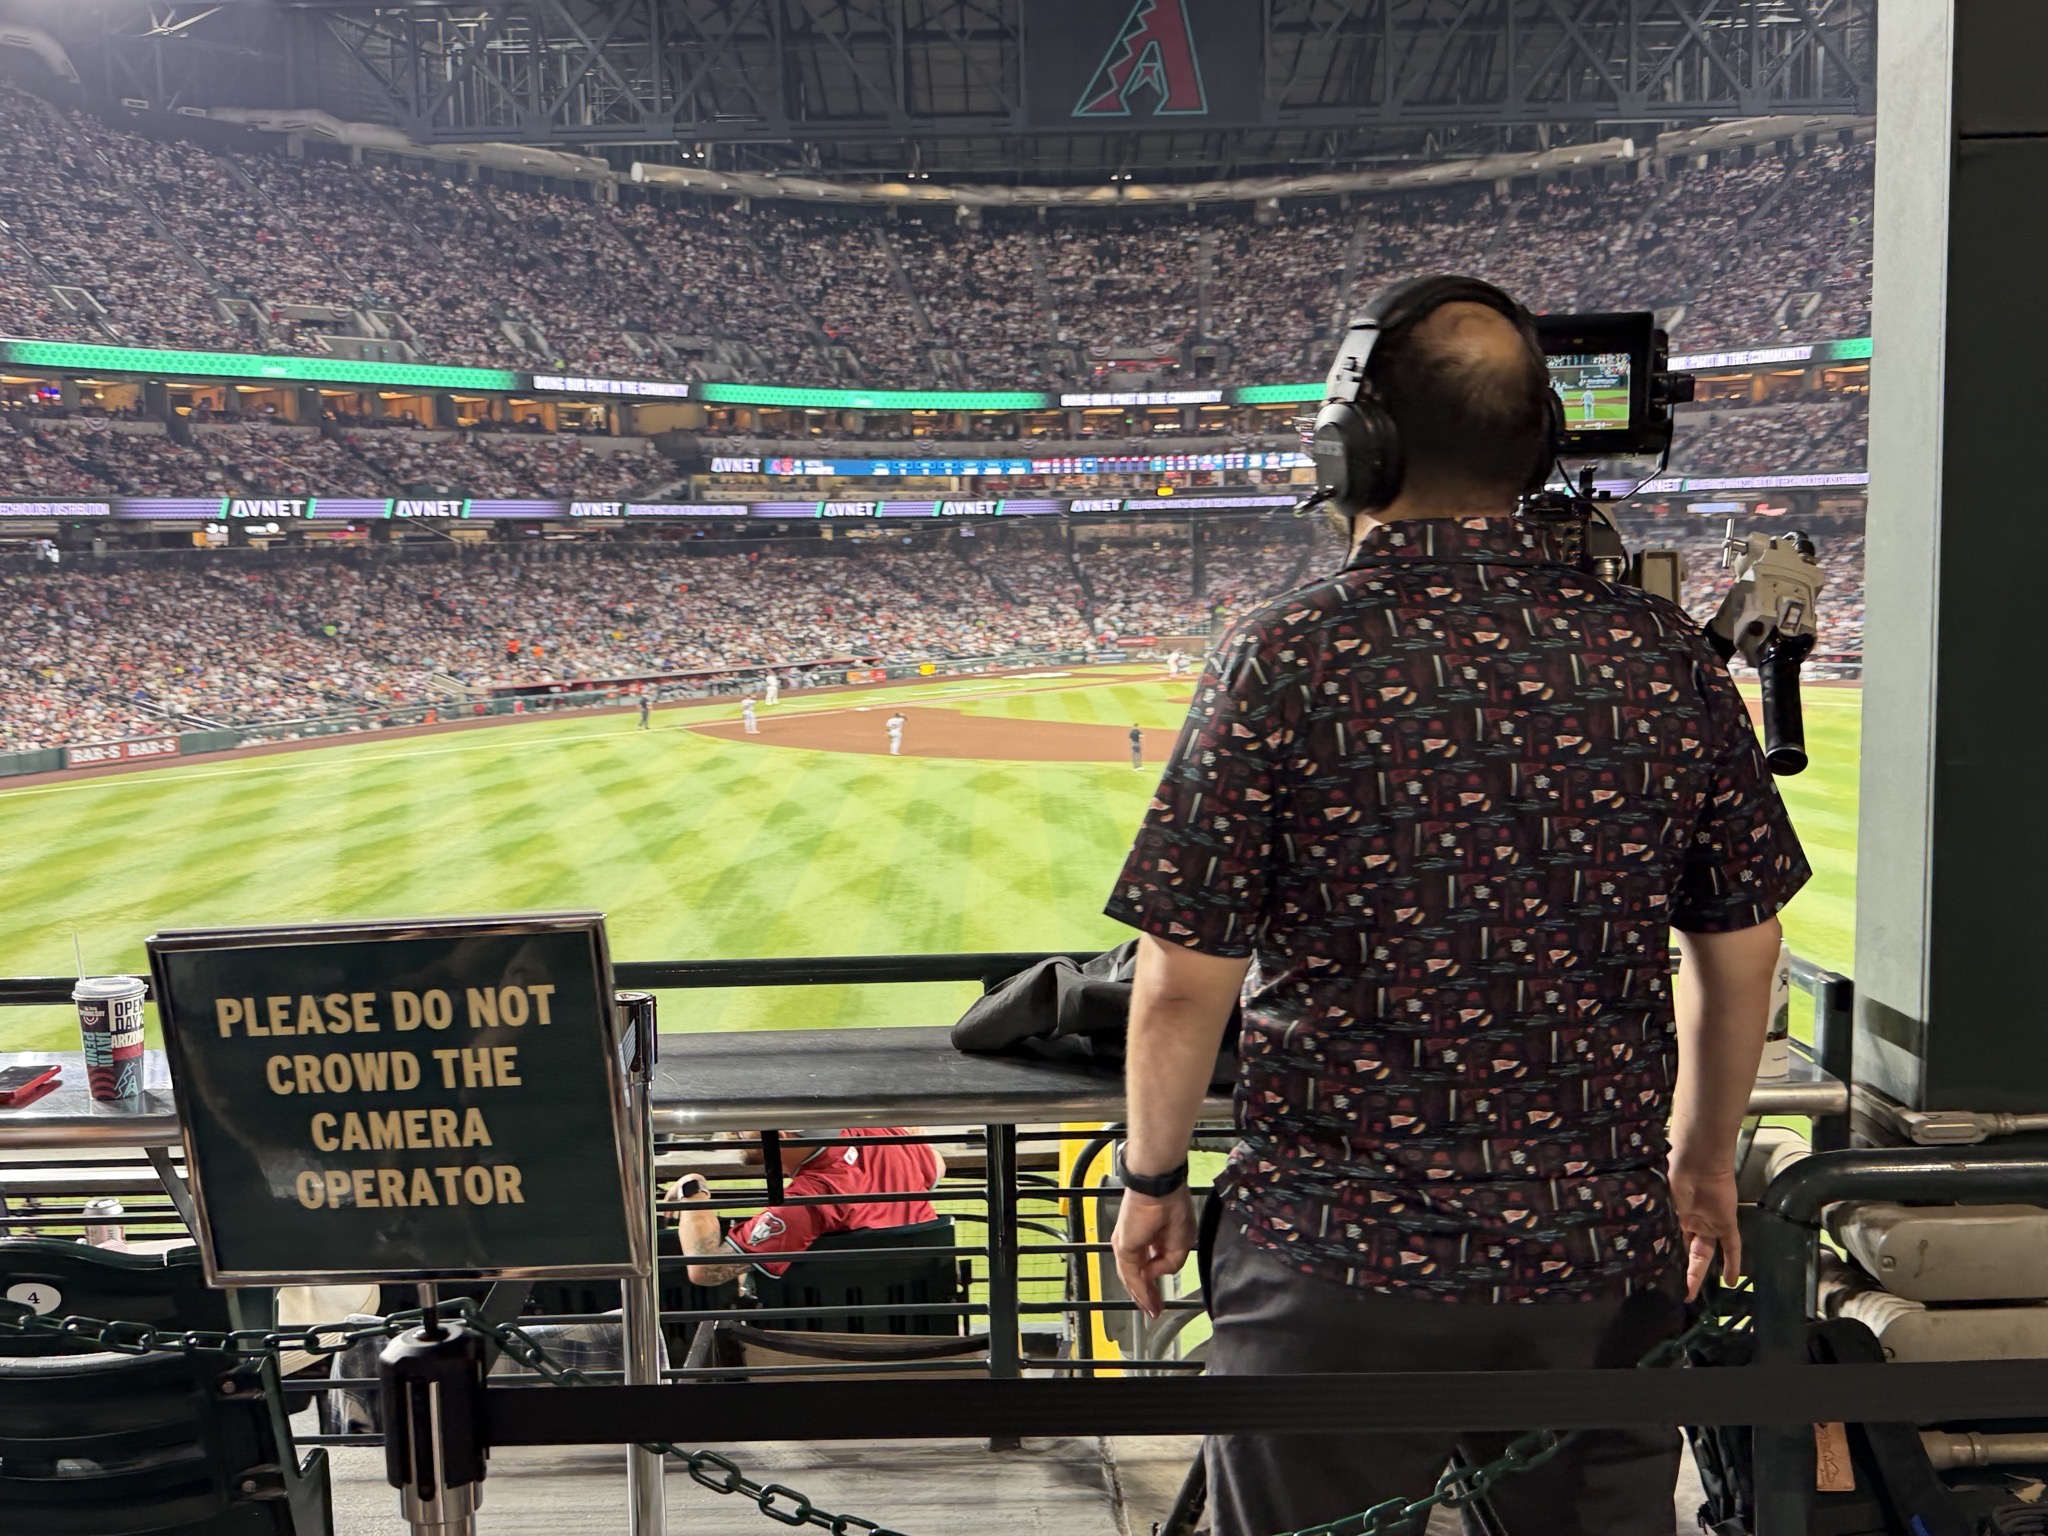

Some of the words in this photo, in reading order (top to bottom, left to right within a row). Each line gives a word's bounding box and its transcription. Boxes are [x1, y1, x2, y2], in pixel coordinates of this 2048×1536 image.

[711, 458, 760, 473] AVNET
[230, 500, 306, 517] AVNET
[395, 500, 463, 517] AVNET
[569, 502, 623, 516] AVNET
[823, 502, 876, 517] AVNET
[942, 501, 997, 516] AVNET
[70, 745, 121, 763] BAR-S
[127, 739, 176, 757] BAR-S
[214, 992, 380, 1038] PLEASE
[393, 989, 453, 1032] DO
[466, 984, 556, 1028] NOT
[266, 1051, 421, 1095] CROWD
[432, 1046, 522, 1089] THE
[311, 1108, 493, 1152] CAMERA
[296, 1165, 525, 1209] OPERATOR
[27, 1291, 41, 1305] 4
